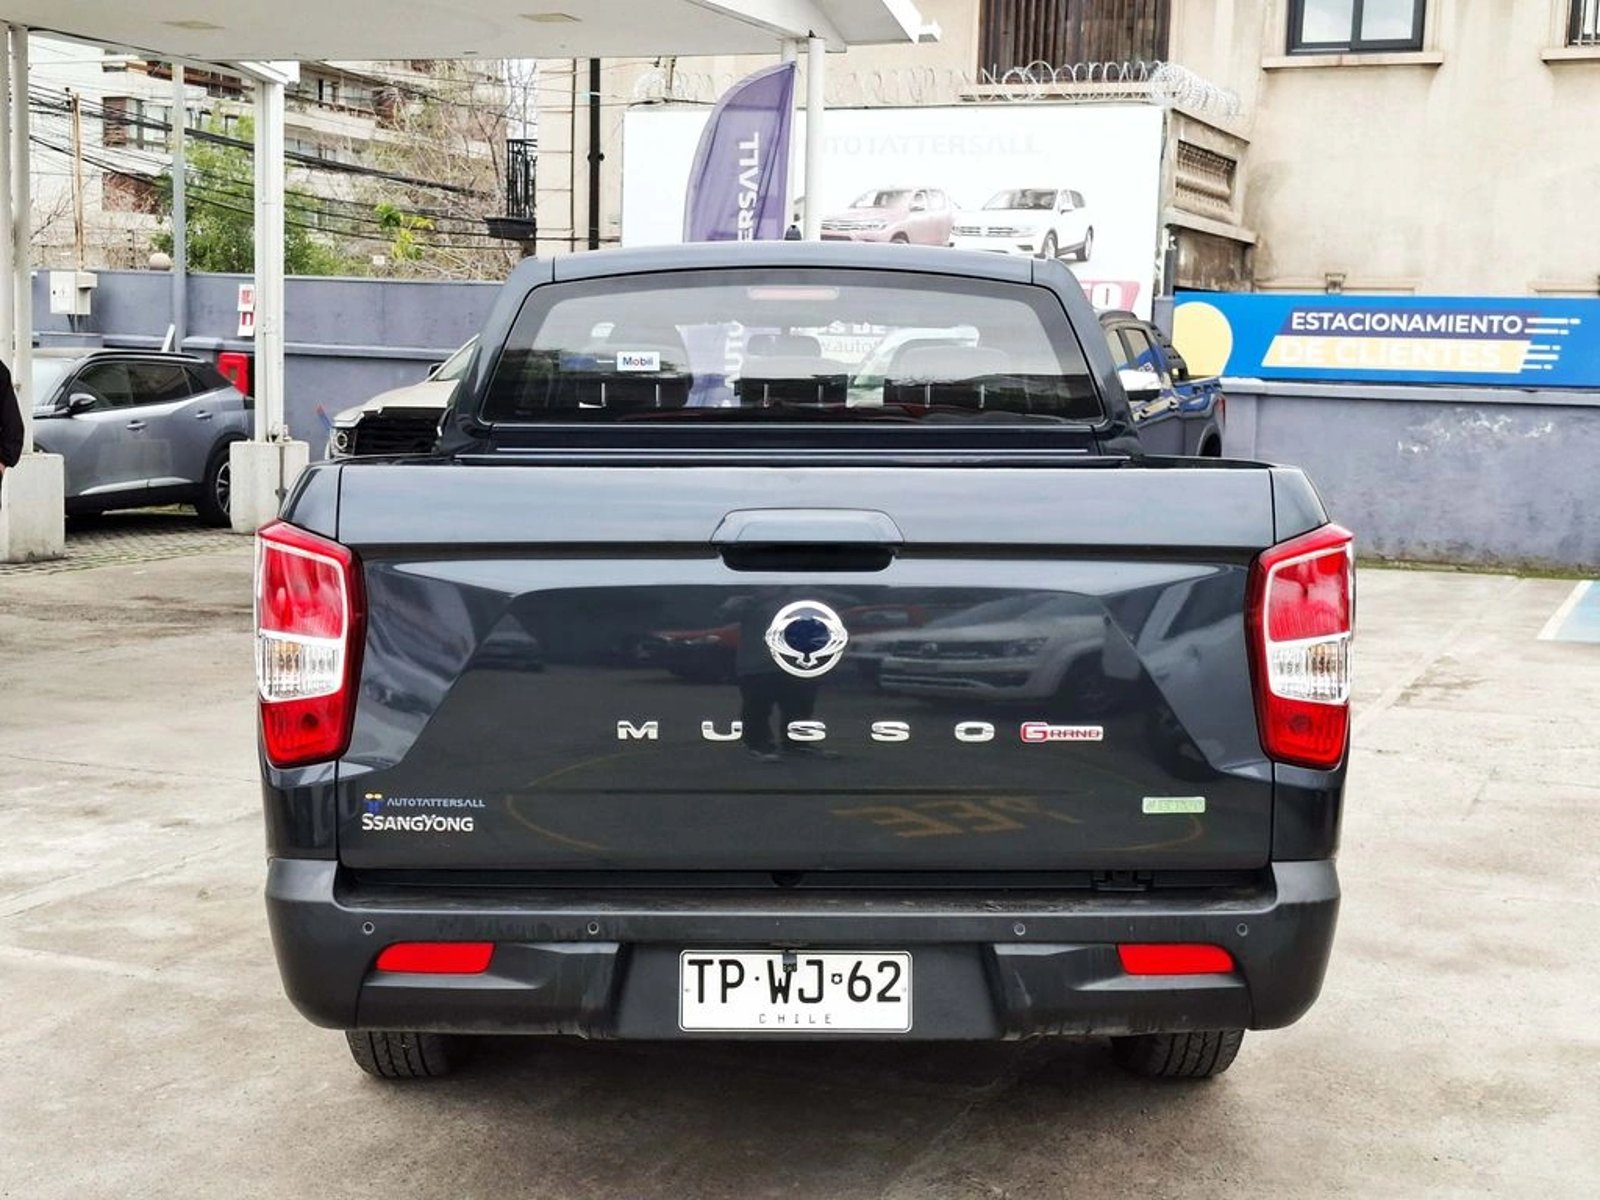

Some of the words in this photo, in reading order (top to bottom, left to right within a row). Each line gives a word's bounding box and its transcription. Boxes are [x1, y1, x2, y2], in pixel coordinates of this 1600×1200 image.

[1291, 311, 1523, 334] ESTACIONAMIENTO
[622, 356, 654, 366] Mobil
[1279, 340, 1324, 364] DE
[1334, 340, 1498, 369] CLIENTES
[617, 720, 995, 742] MUSSO
[387, 797, 486, 808] AUTOTATTERSALL
[758, 1013, 833, 1025] CHILE
